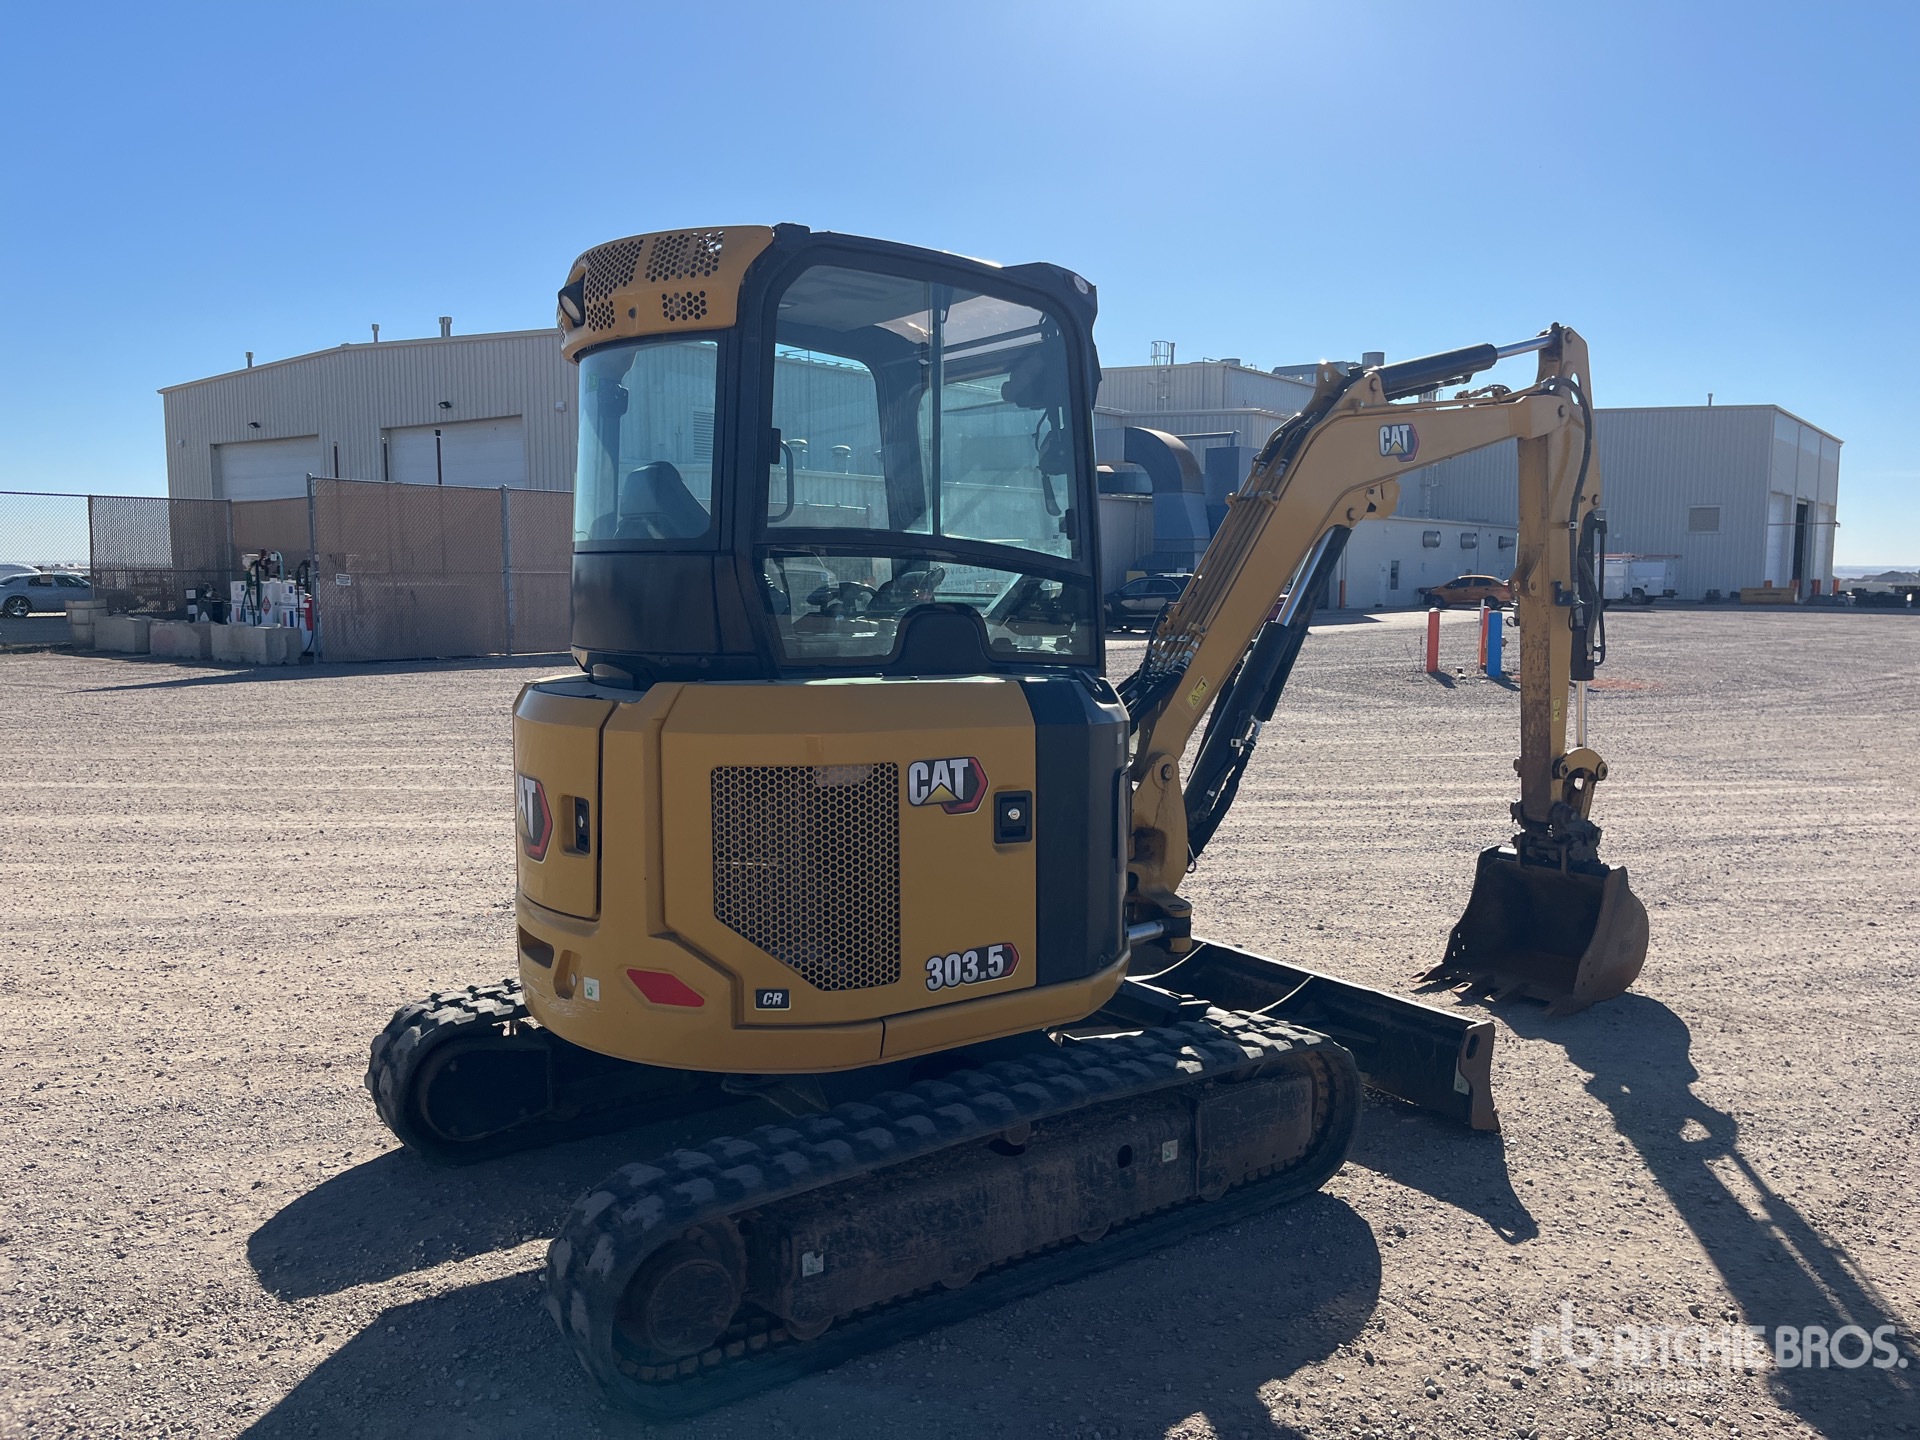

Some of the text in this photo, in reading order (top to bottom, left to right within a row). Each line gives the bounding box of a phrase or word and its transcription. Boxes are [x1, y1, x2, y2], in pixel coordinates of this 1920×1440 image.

[1380, 424, 1410, 456] CAT
[908, 758, 969, 806] CAT
[516, 774, 536, 840] AT
[926, 944, 1004, 990] 303.5
[762, 992, 783, 1006] CR
